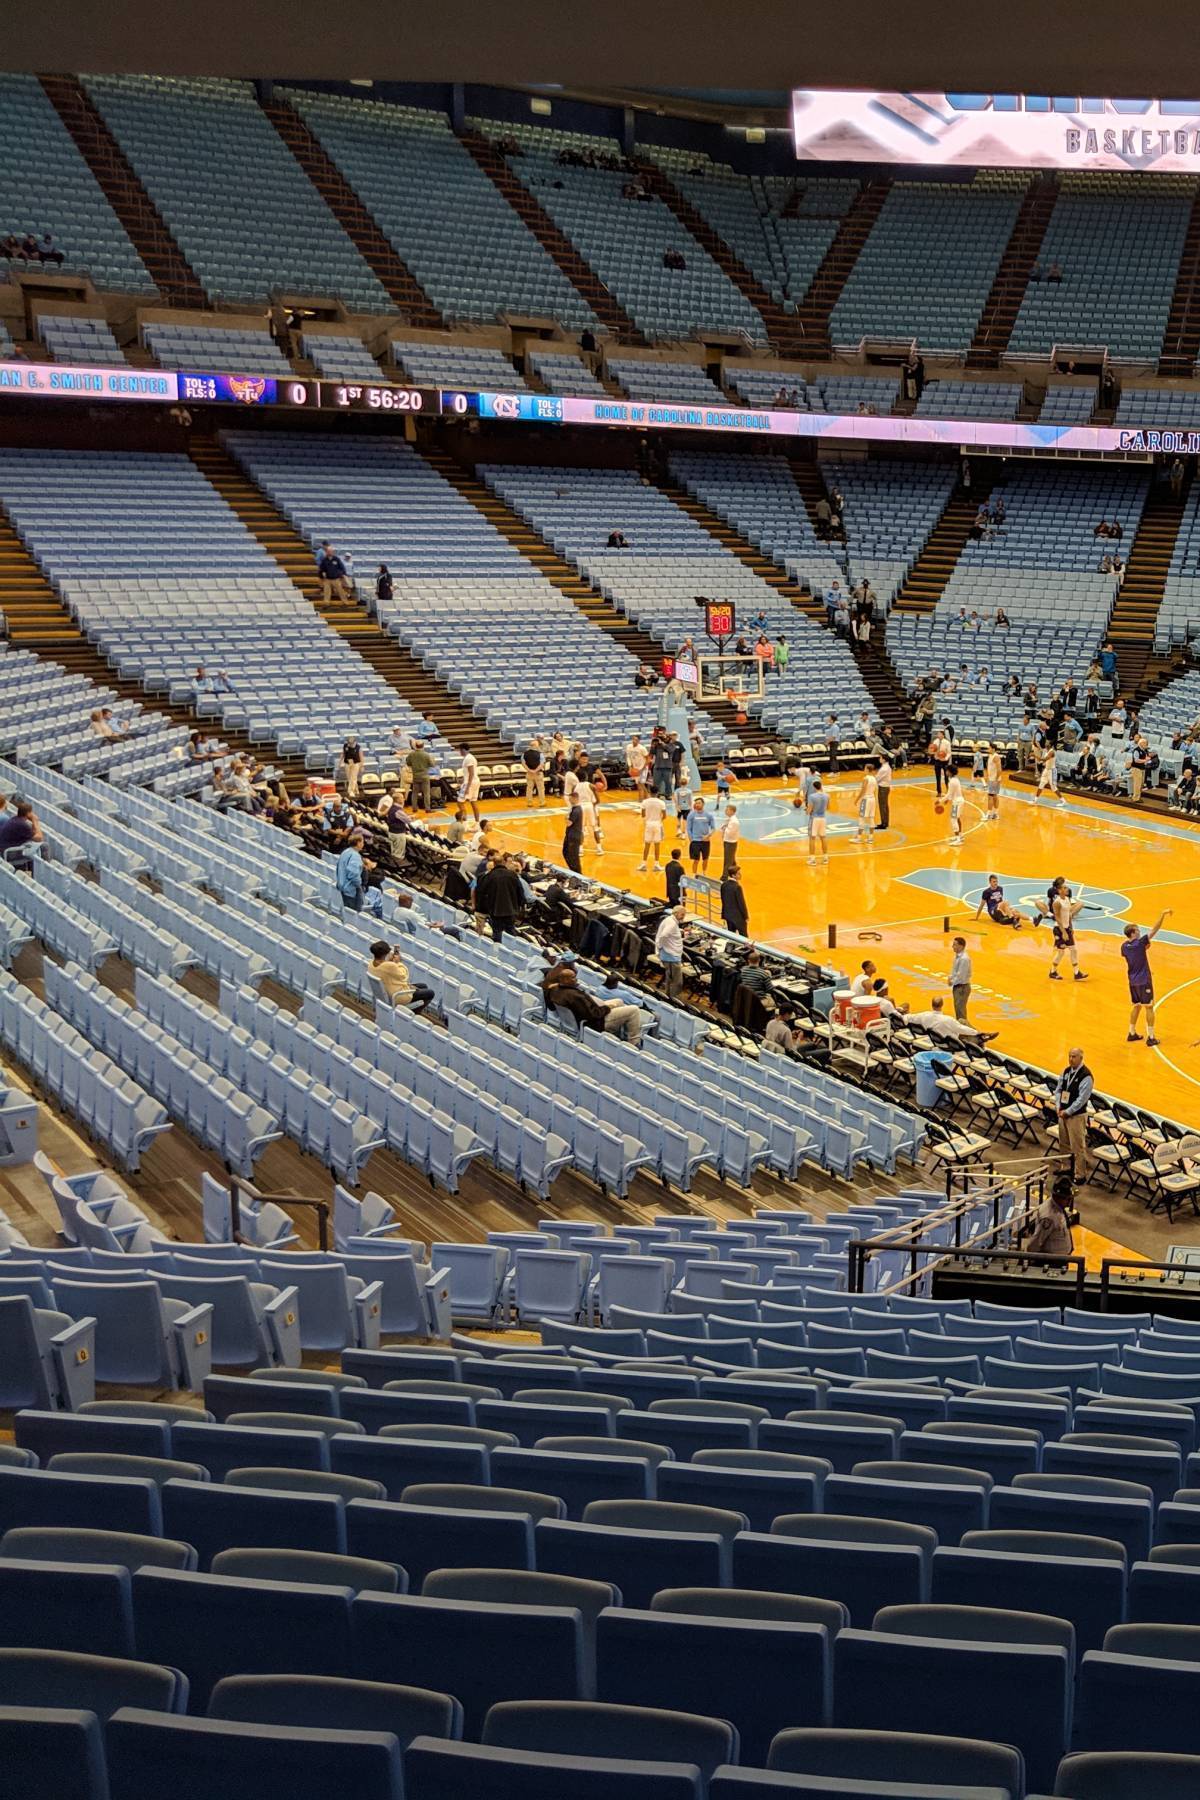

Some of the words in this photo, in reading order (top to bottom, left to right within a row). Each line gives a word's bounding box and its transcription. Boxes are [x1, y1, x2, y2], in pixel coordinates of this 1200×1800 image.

[28, 371, 44, 388] E.
[50, 372, 103, 391] SMITH
[108, 375, 168, 394] CENTER
[184, 378, 206, 389] TOL:
[208, 380, 215, 389] 4
[186, 388, 207, 398] FLS:
[208, 389, 216, 398] 0
[292, 384, 307, 404] 0
[337, 387, 363, 406] 1ST
[369, 389, 423, 410] 56:20
[454, 394, 467, 413] 0
[537, 399, 555, 409] TOL:
[556, 400, 561, 409] 4
[538, 408, 556, 417] FLS:
[556, 409, 562, 418] 0
[594, 404, 628, 420] HOME
[631, 407, 645, 421] OF
[649, 408, 703, 425] CAROLINA
[706, 412, 771, 430] BASKETBALL
[712, 616, 729, 631] 30
